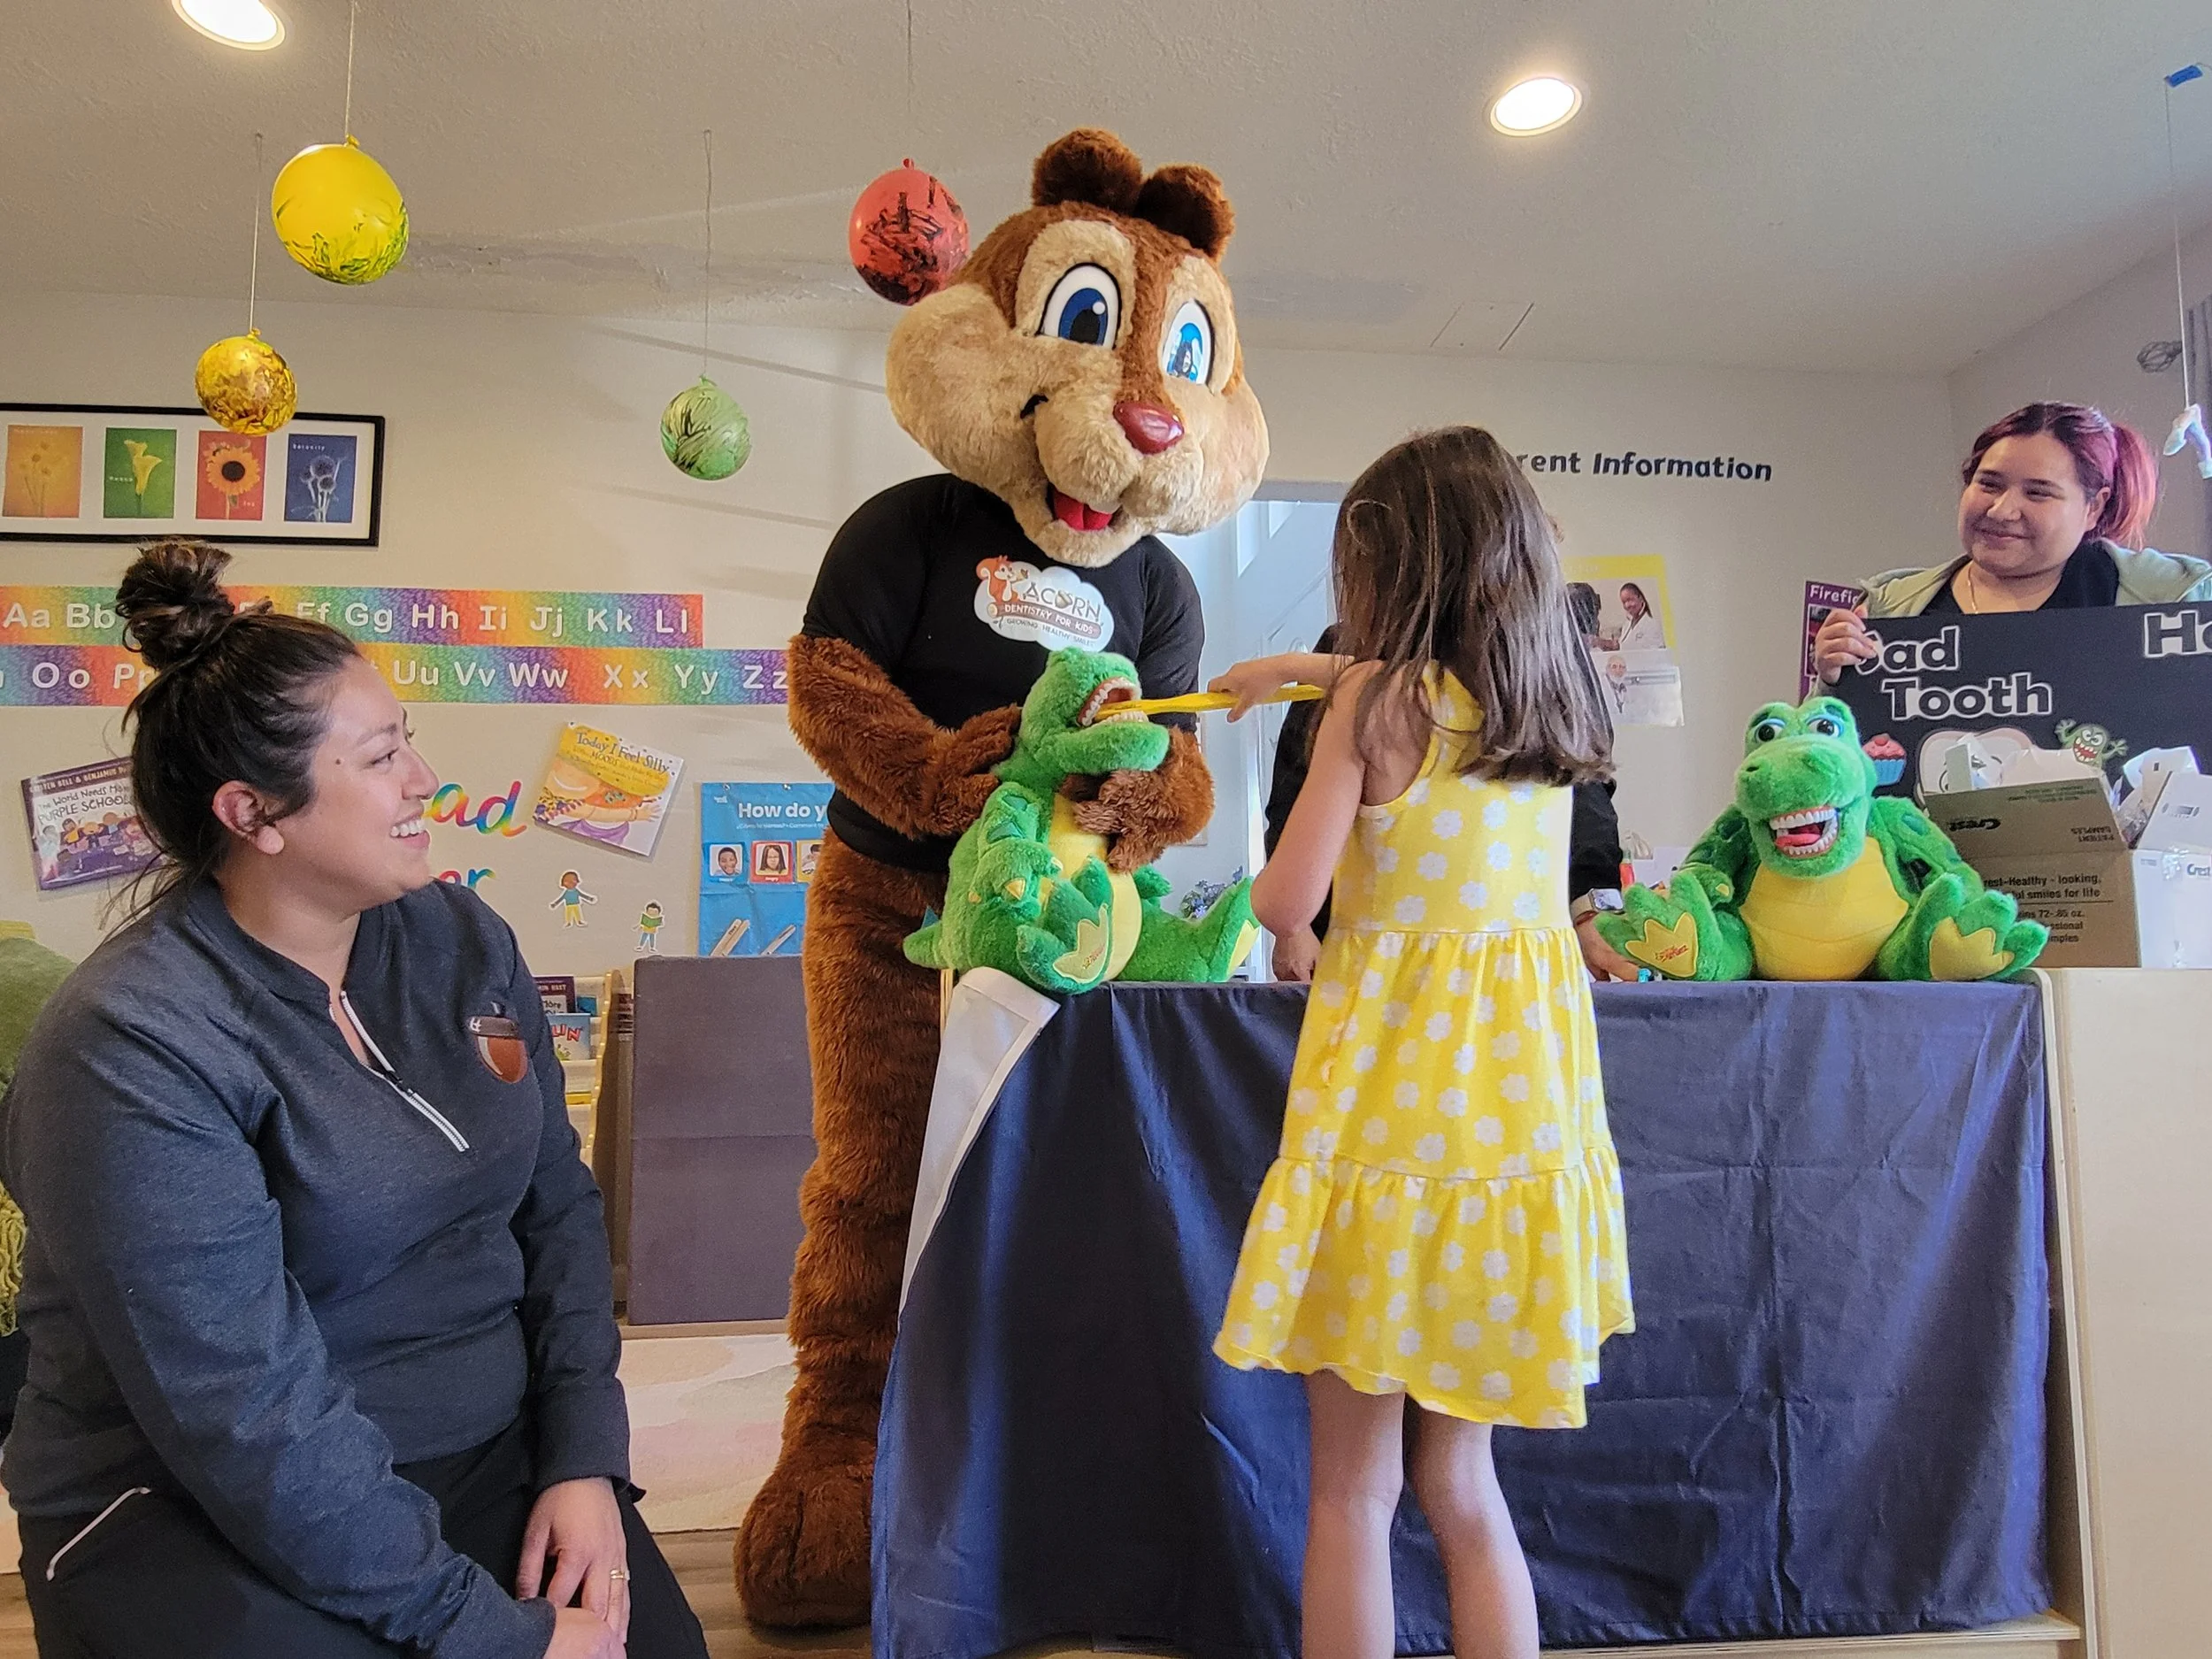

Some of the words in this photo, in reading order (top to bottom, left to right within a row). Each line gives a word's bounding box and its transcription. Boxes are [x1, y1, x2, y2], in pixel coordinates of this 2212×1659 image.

[1516, 452, 1581, 473] rent
[1593, 451, 1772, 482] Information
[1022, 581, 1102, 622] ACORN
[2, 602, 50, 629] Aa
[65, 603, 116, 629] Bb
[345, 603, 394, 634] Gg
[411, 603, 459, 631] Hh
[479, 605, 508, 631] Ii
[530, 606, 565, 638] Jj
[588, 608, 634, 634] Kk
[1004, 603, 1052, 620] DENTISTRY
[1055, 614, 1071, 627] FOR
[1075, 620, 1094, 634] KIDS
[1006, 618, 1039, 629] GROWING
[1042, 625, 1072, 640] HEALTHY
[32, 663, 90, 689] Oo
[393, 661, 439, 686] Uu
[453, 661, 496, 687] Vv
[509, 663, 569, 688] Ww
[603, 664, 649, 689] Xx
[673, 664, 719, 695] Yy
[1881, 672, 2052, 720] Tooth
[576, 732, 610, 751] Today
[610, 742, 618, 755] I
[619, 746, 641, 764] Feel
[643, 754, 671, 774] Silly
[38, 803, 78, 825] PURPLE
[81, 795, 132, 811] SCHOOL
[52, 792, 79, 807] World
[81, 786, 107, 798] Needs
[421, 780, 527, 837] ad
[738, 803, 782, 818] How
[785, 803, 810, 818] do
[815, 805, 828, 822] y
[1949, 818, 2001, 831] Crest
[2027, 889, 2062, 899] smiles
[2064, 887, 2079, 898] for
[2083, 887, 2101, 897] life
[2049, 921, 2083, 930] ssional
[2049, 933, 2078, 943] mples
